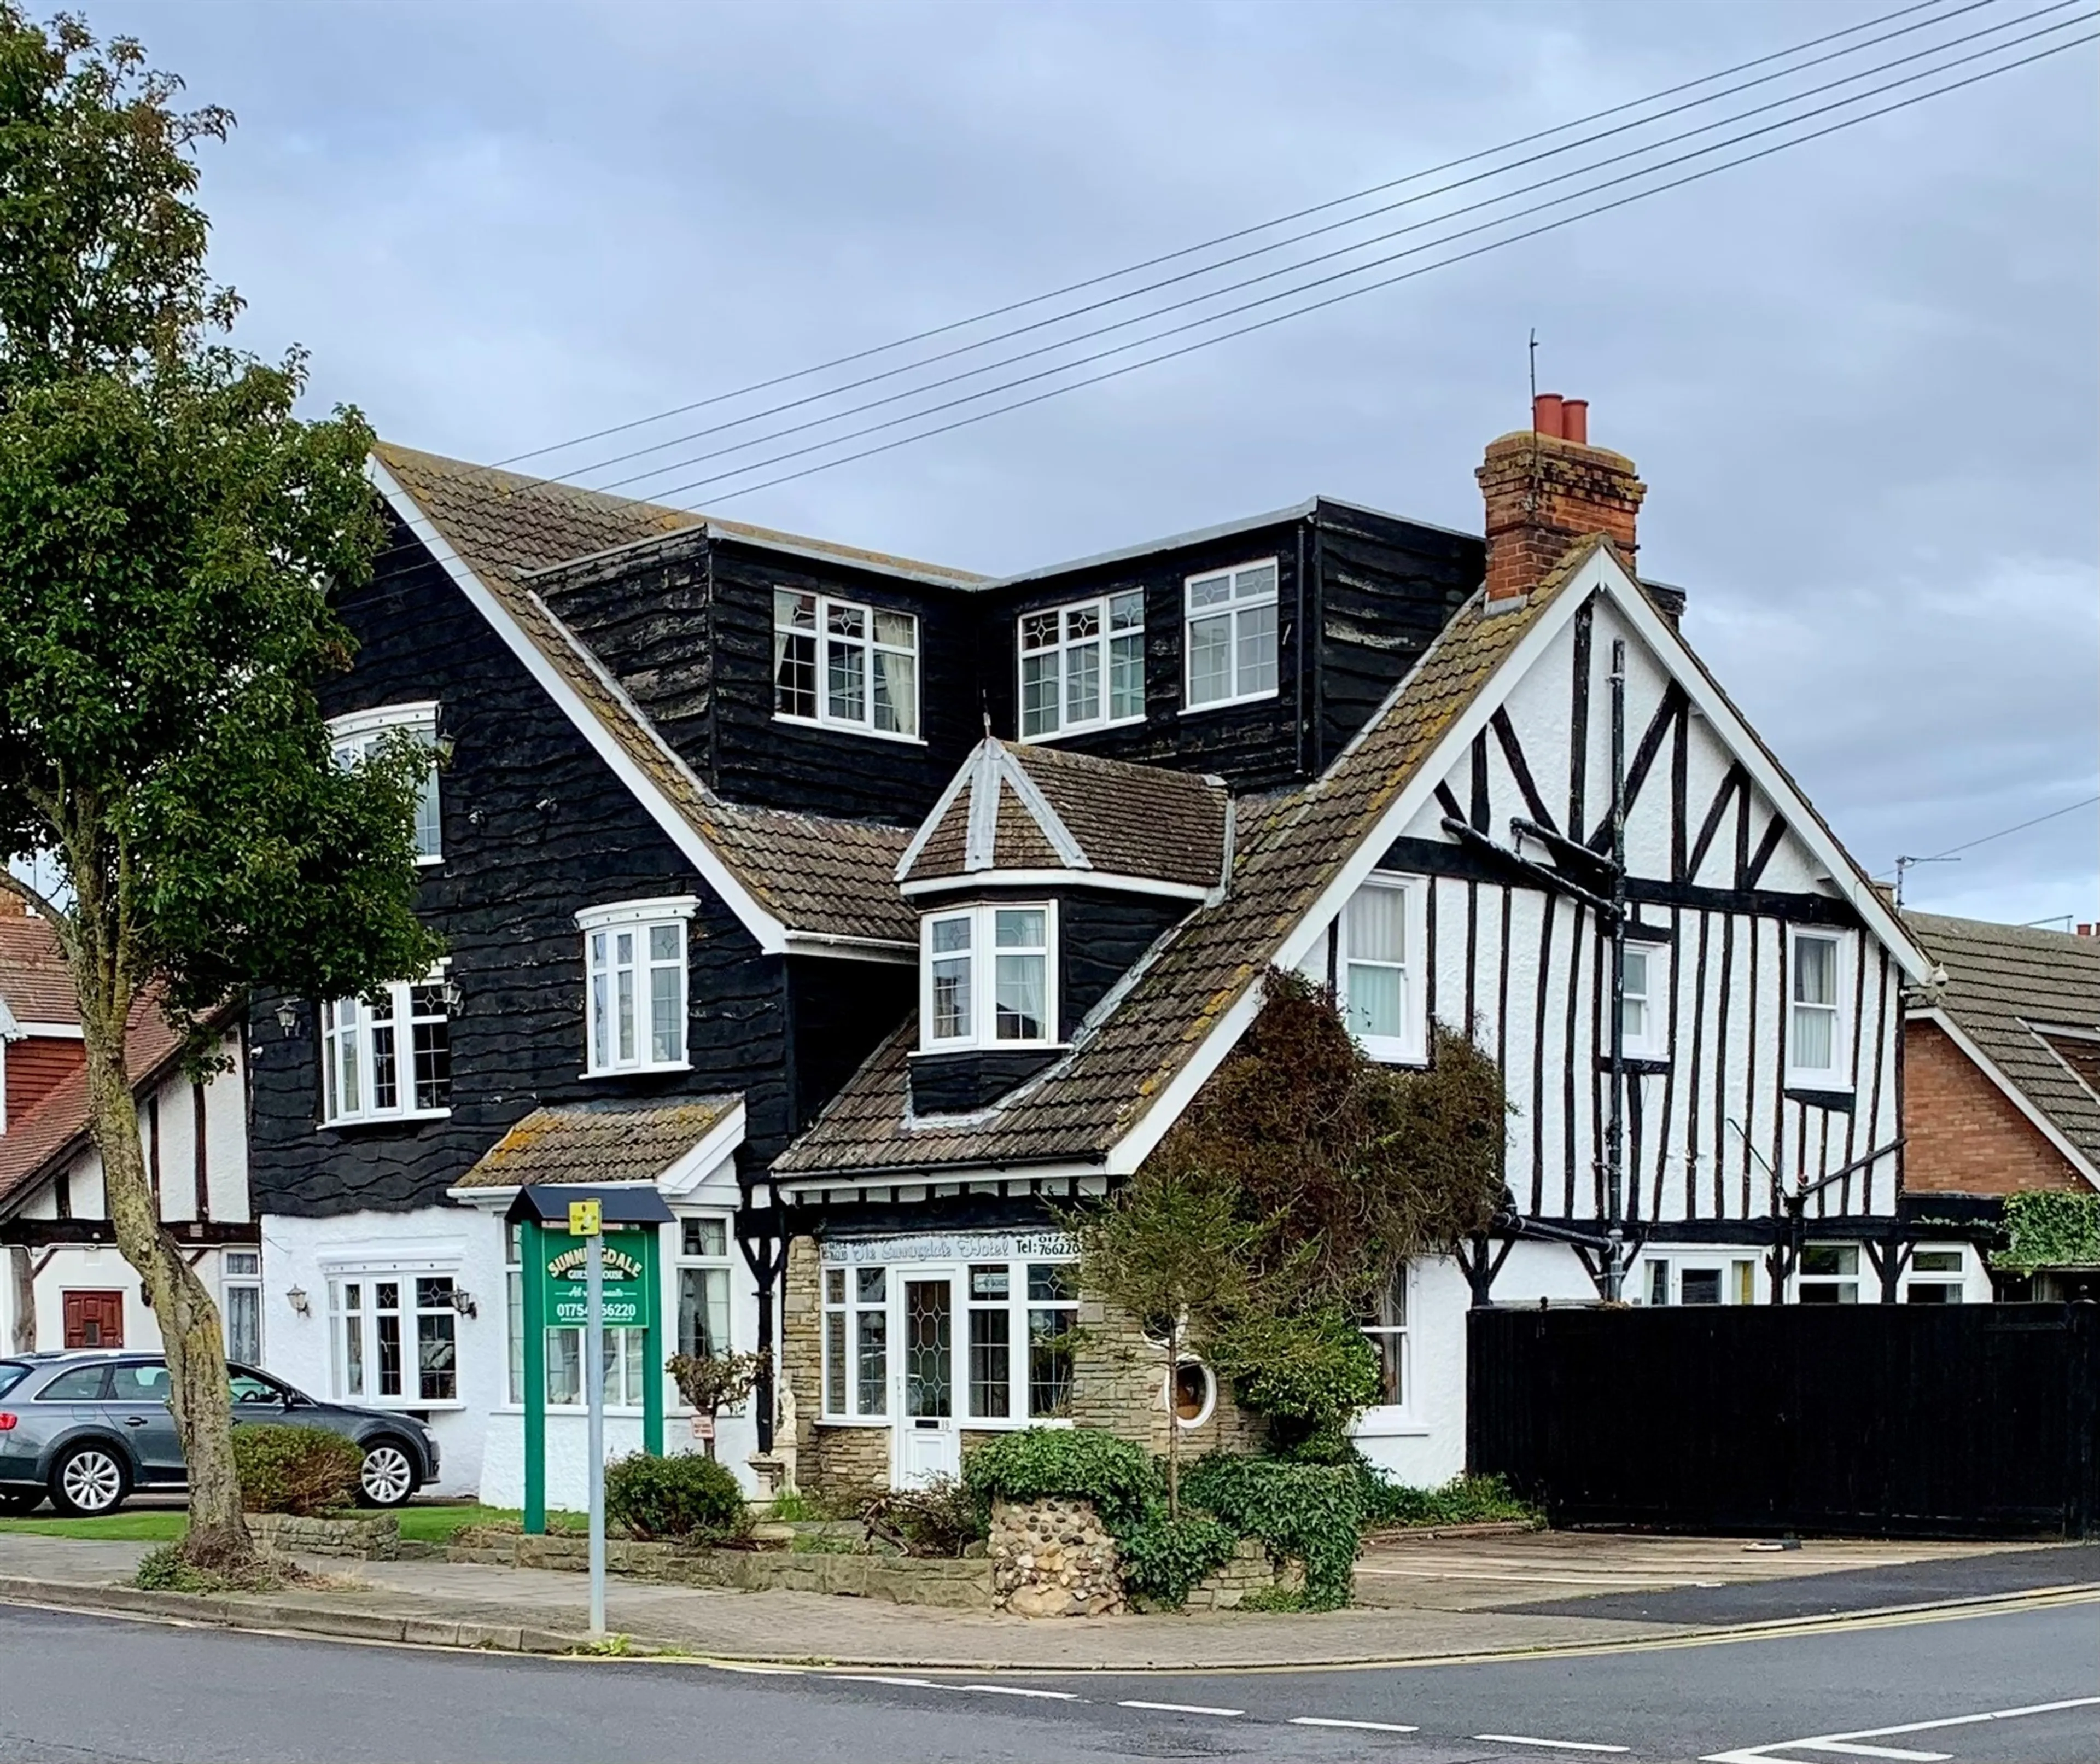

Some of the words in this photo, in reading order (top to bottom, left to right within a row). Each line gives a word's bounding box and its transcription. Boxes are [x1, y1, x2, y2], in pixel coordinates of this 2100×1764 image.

[958, 1237, 1009, 1257] Hotel
[1016, 1239, 1037, 1254] Tel:
[1039, 1243, 1081, 1255] 766220
[547, 1247, 643, 1278] SUNNIGDALE
[567, 1270, 588, 1280] GUES
[602, 1270, 625, 1280] OUSE
[602, 1303, 637, 1317] 66220
